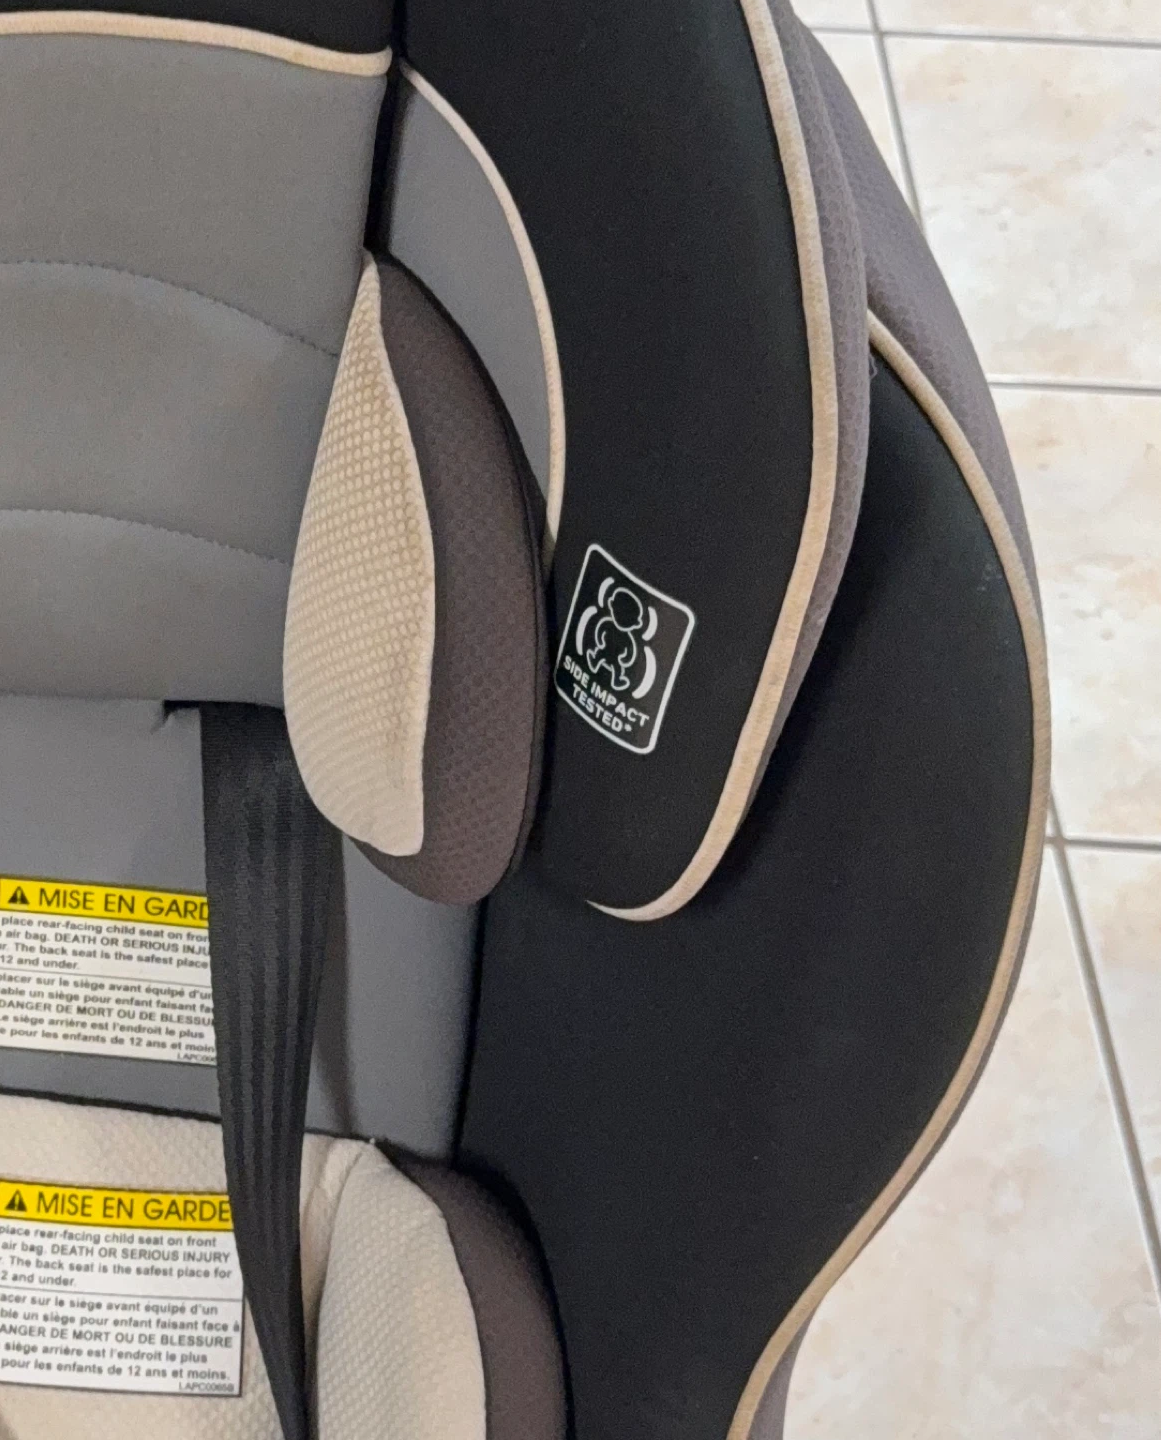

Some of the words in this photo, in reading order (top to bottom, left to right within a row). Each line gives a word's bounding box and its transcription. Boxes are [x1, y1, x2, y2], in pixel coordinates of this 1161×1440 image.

[563, 655, 590, 688] SIDE
[591, 682, 649, 726] IMPACT
[39, 887, 94, 910] MISE
[104, 894, 135, 914] EN
[1, 915, 33, 926] place
[38, 919, 102, 934] rear-facing
[106, 925, 135, 935] child
[140, 928, 164, 937] seat
[6, 929, 21, 938] air
[55, 933, 96, 944] DEATH
[101, 937, 119, 946] OR
[123, 939, 179, 953] SERIOUS
[0, 954, 13, 964] 12
[17, 956, 38, 966] and
[14, 942, 35, 952] The
[40, 944, 68, 956] back
[72, 949, 96, 958] seat
[101, 950, 111, 959] is
[114, 951, 133, 960] the
[137, 954, 173, 964] safest
[176, 957, 208, 969] place
[36, 977, 55, 985] sur
[59, 978, 70, 987] le
[73, 978, 105, 991] siège
[109, 983, 141, 993] avant
[145, 985, 185, 998] équipé
[29, 988, 44, 998] un
[48, 989, 79, 1003] siège
[83, 995, 111, 1004] pour
[115, 997, 152, 1008] enfant
[156, 999, 197, 1010] faisant
[56, 1003, 72, 1014] DE
[76, 1005, 114, 1017] MORT
[117, 1009, 135, 1019] OU
[139, 1011, 156, 1021] DE
[13, 1014, 44, 1025] siège
[91, 1021, 109, 1030] est
[166, 1026, 175, 1035] le
[179, 1029, 204, 1039] plus
[10, 1027, 38, 1037] pour
[41, 1030, 58, 1039] les
[62, 1032, 106, 1043] enfants
[110, 1035, 124, 1045] de
[130, 1037, 142, 1046] 12
[146, 1040, 166, 1049] ans
[170, 1041, 181, 1050] et
[37, 1192, 93, 1217] MISE
[103, 1197, 134, 1219] EN
[144, 1199, 230, 1222] GARDE
[34, 1229, 100, 1243] rear-facing
[105, 1233, 134, 1243] child
[139, 1235, 163, 1245] seat
[167, 1237, 182, 1246] on
[187, 1236, 216, 1247] front
[2, 1241, 17, 1250] air
[51, 1244, 93, 1257] DEATH
[98, 1247, 117, 1258] OR
[121, 1249, 179, 1261] SERIOUS
[183, 1251, 230, 1263] INJURY
[9, 1255, 31, 1267] The
[35, 1259, 64, 1270] back
[69, 1262, 94, 1272] seat
[98, 1263, 108, 1272] is
[113, 1264, 132, 1274] the
[136, 1266, 173, 1277] safest
[177, 1268, 210, 1279] place
[214, 1267, 232, 1278] for
[12, 1272, 34, 1283] and
[30, 1295, 51, 1305] sur
[55, 1297, 64, 1307] le
[106, 1302, 140, 1311] avant
[144, 1301, 186, 1315] équipé
[190, 1304, 218, 1315] d'un
[23, 1312, 38, 1321] un
[43, 1311, 75, 1325] siège
[80, 1316, 108, 1326] pour
[113, 1317, 152, 1328] enfant
[156, 1318, 198, 1330] faisant
[202, 1320, 228, 1332] face
[50, 1328, 68, 1339] DE
[72, 1330, 110, 1342] MORT
[115, 1332, 134, 1344] OU
[139, 1334, 155, 1345] DE
[161, 1334, 233, 1348] BLESSURE
[4, 1341, 38, 1355] siège
[42, 1345, 83, 1357] arrière
[87, 1348, 106, 1358] est
[166, 1351, 176, 1361] le
[180, 1352, 207, 1363] plus
[0, 1358, 30, 1369] pour
[34, 1359, 52, 1371] les
[56, 1362, 103, 1374] enfants
[107, 1364, 122, 1375] de
[128, 1365, 141, 1377] 12
[145, 1369, 167, 1378] ans
[171, 1369, 183, 1378] et
